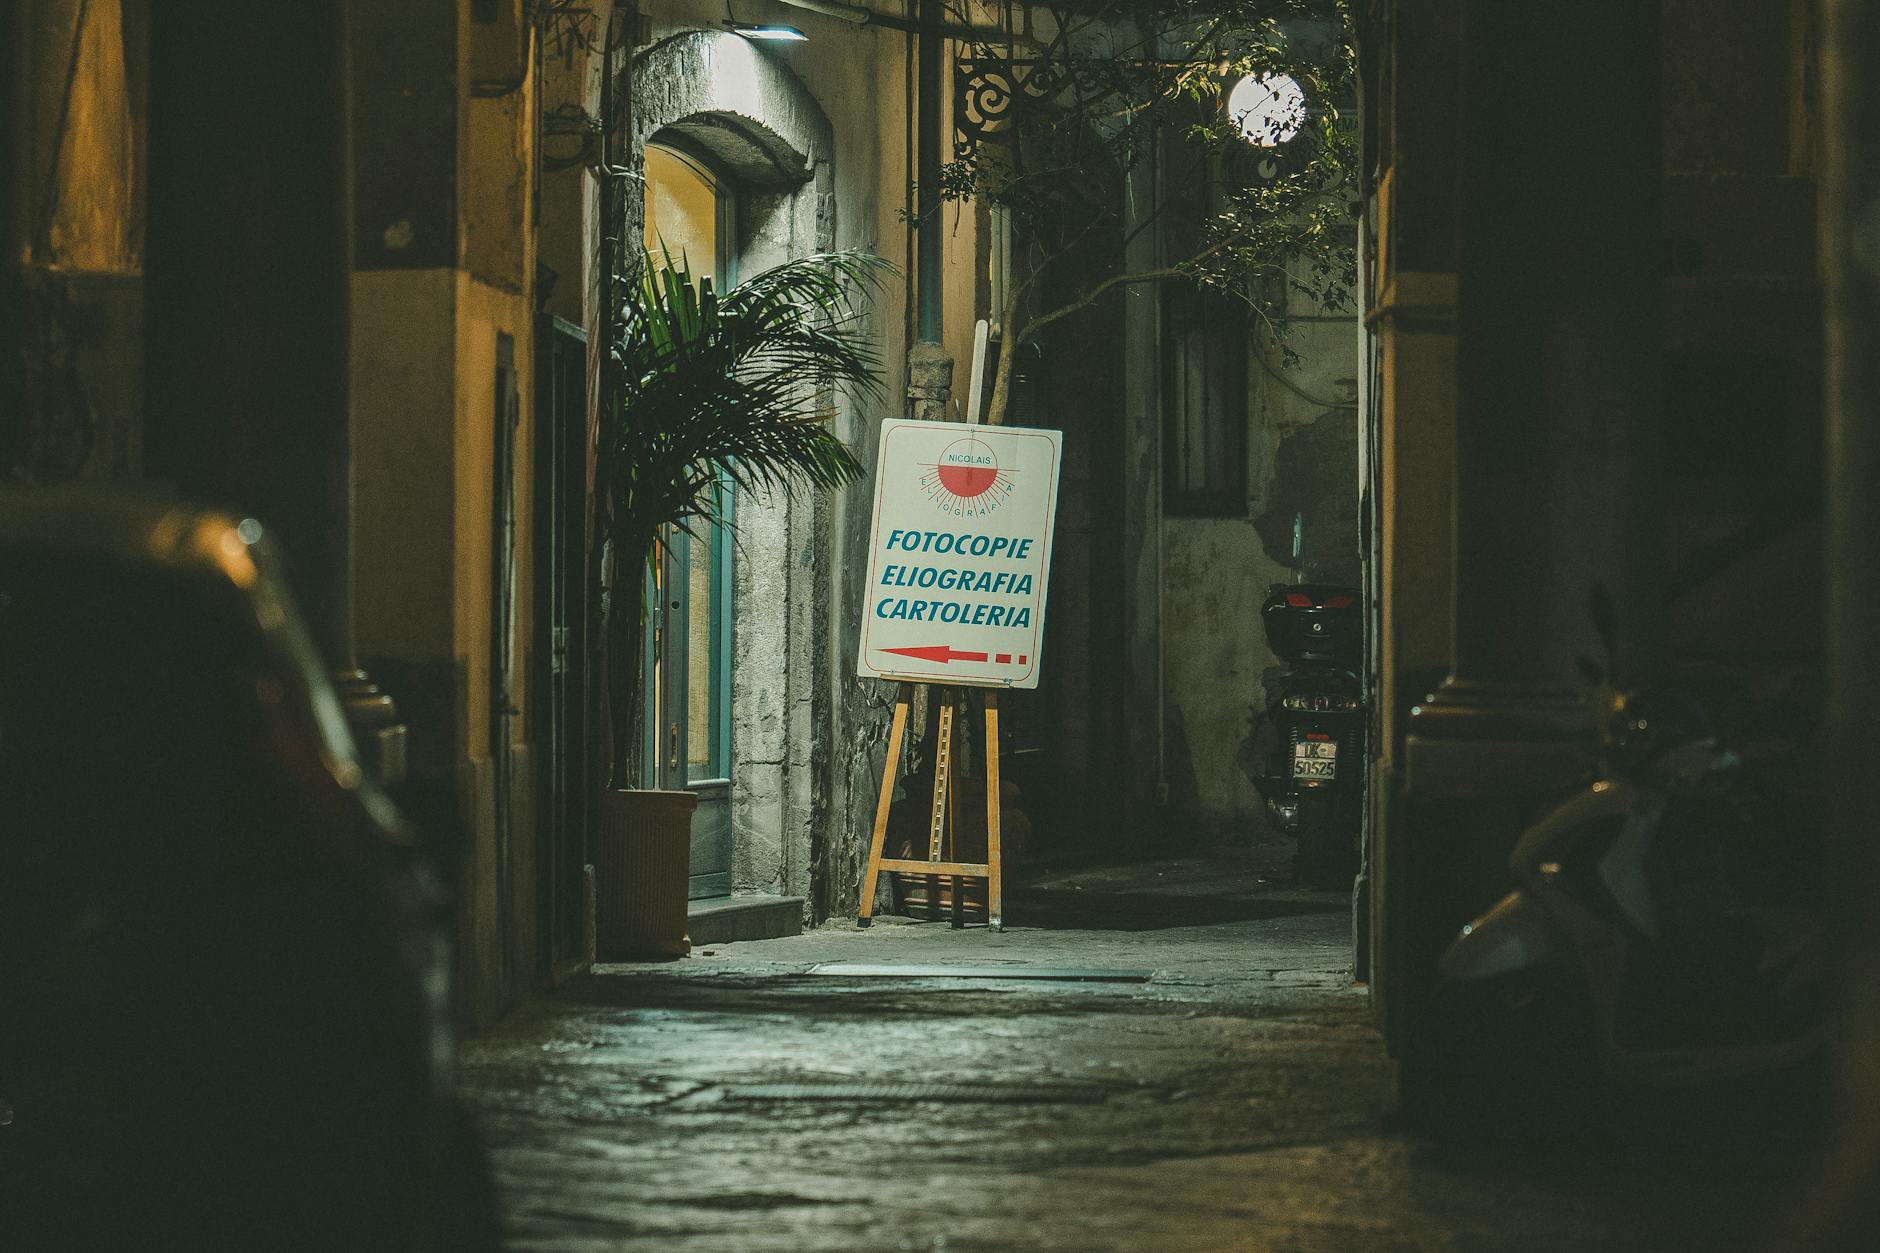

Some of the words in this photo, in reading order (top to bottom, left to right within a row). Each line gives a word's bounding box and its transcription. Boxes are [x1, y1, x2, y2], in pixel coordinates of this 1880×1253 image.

[948, 454, 991, 464] NICOLAIS
[921, 478, 1012, 516] ELIOGRAFIA
[886, 529, 1033, 560] FOTOCOPIE
[880, 564, 1032, 594] ELIOGRAFIA
[876, 598, 1030, 628] CARTOLERIA
